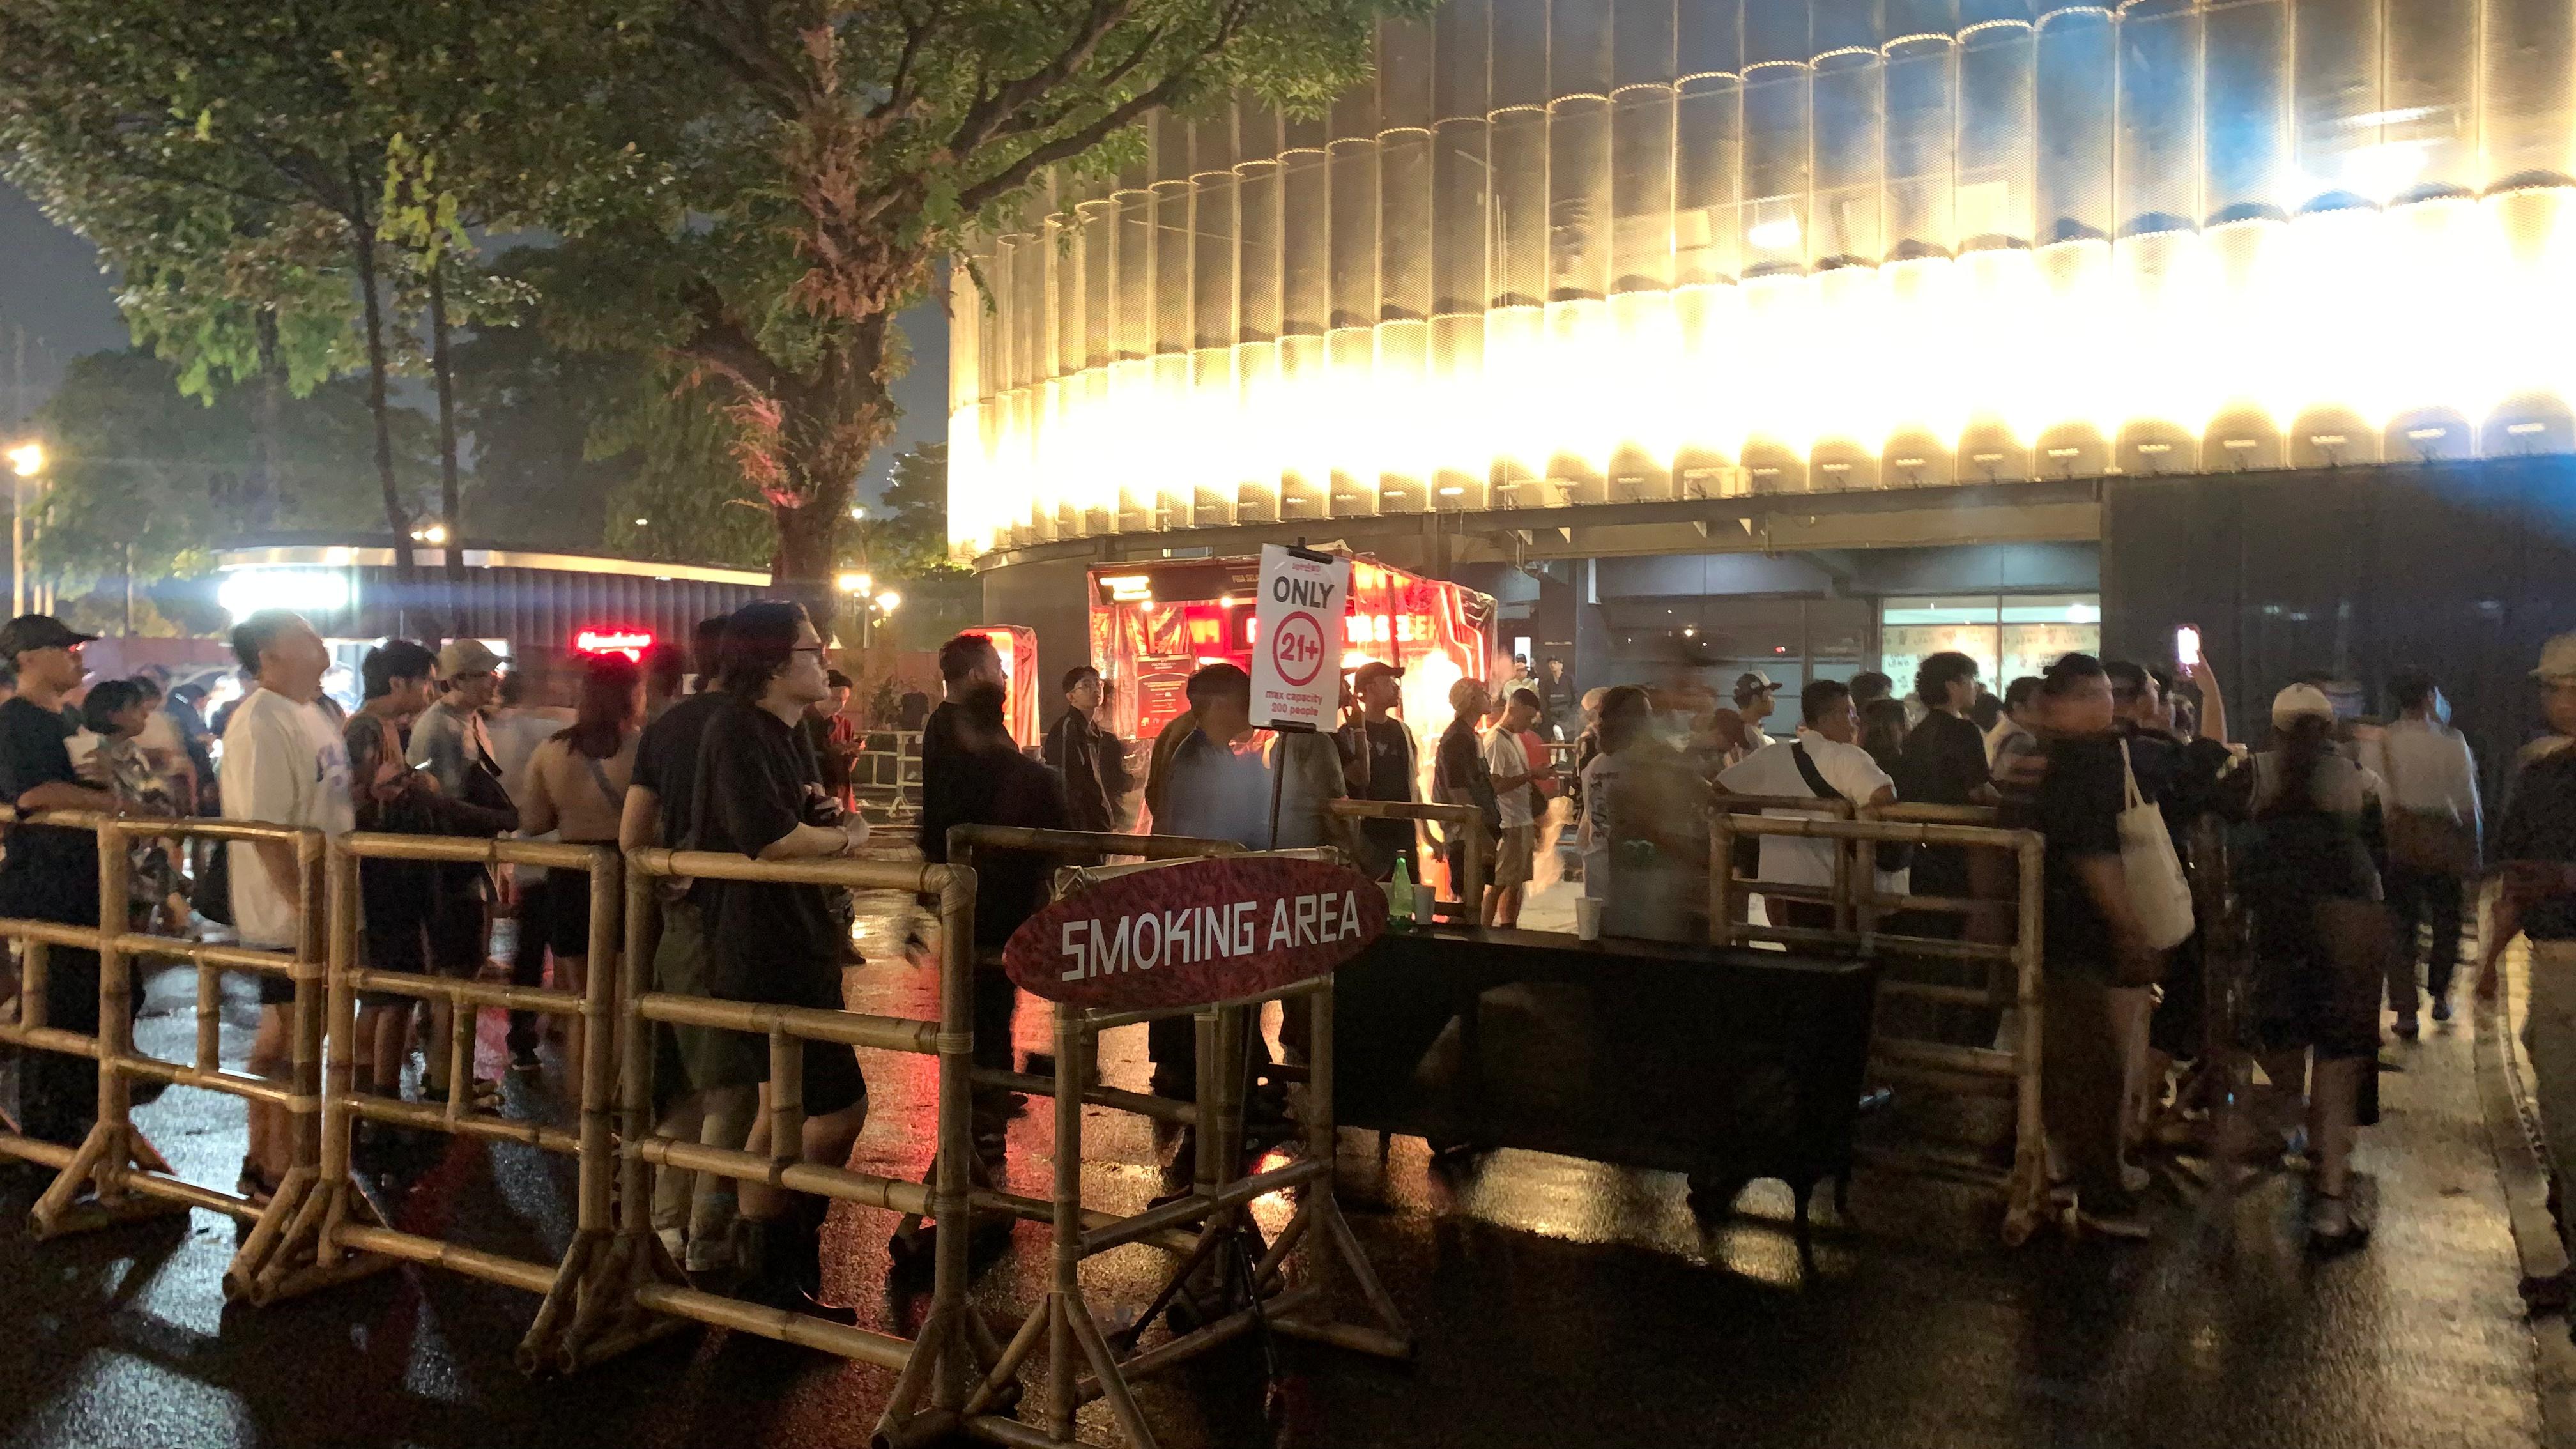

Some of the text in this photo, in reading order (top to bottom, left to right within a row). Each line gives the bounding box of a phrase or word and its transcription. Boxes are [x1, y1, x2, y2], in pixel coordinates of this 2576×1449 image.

[1273, 576, 1335, 609] ONLY
[1280, 632, 1319, 662] 21+
[1266, 691, 1322, 705] max capacity
[1272, 702, 1318, 717] 200 people
[1062, 890, 1361, 982] SMOKING AREA
